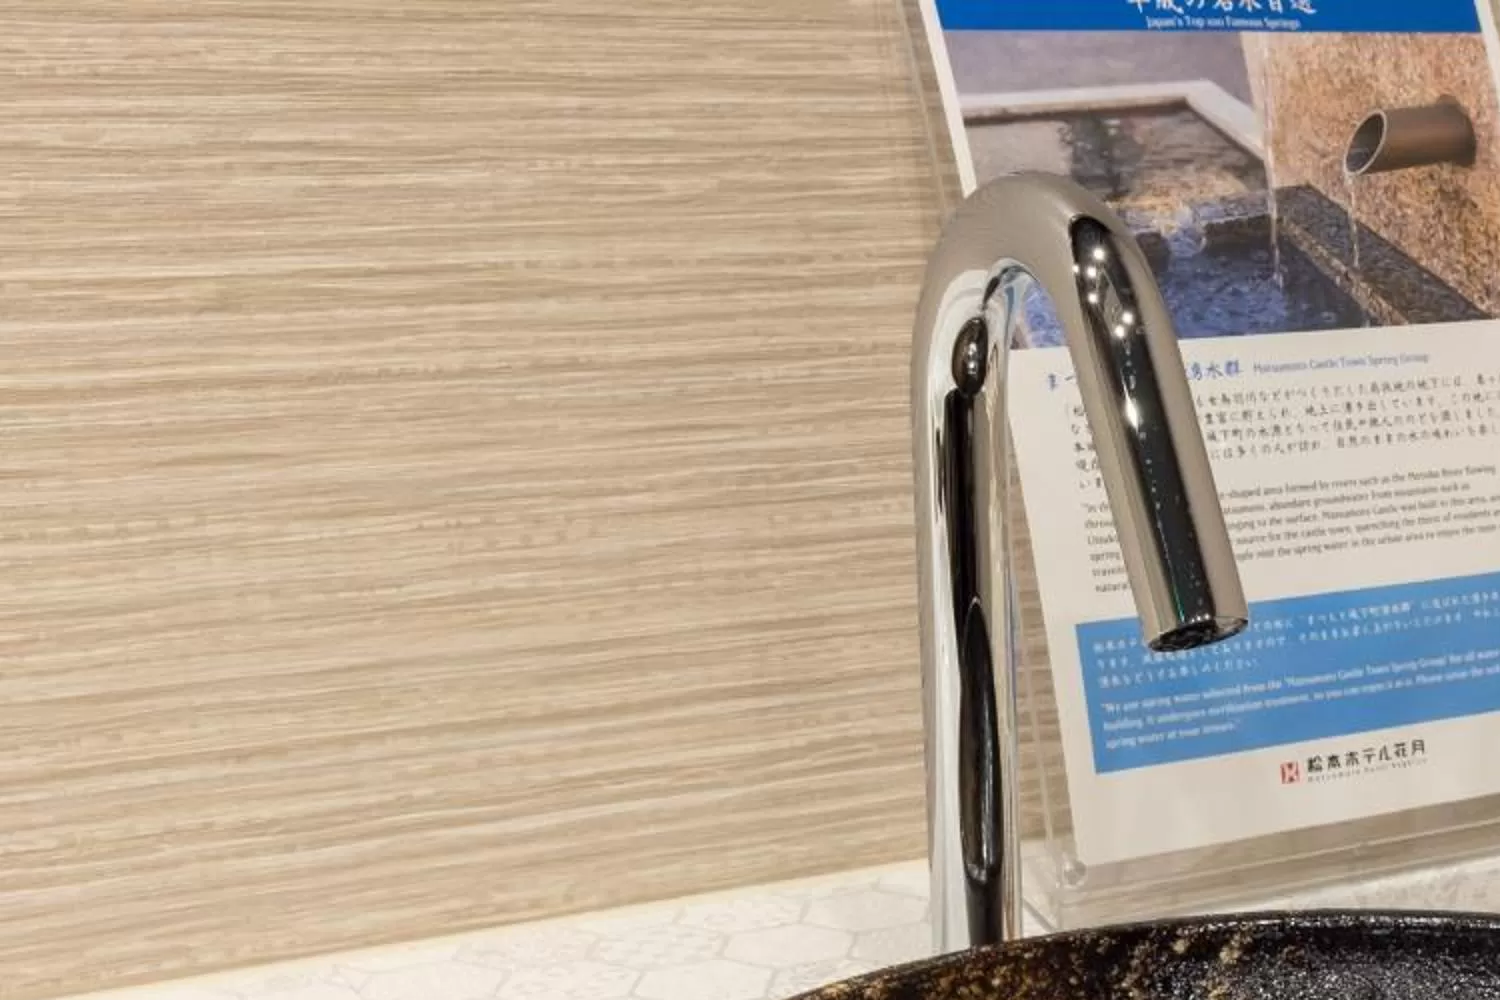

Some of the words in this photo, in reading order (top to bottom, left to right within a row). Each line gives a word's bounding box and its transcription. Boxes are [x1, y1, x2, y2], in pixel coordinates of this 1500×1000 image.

[1185, 16, 1204, 29] Top
[1309, 357, 1338, 369] Castle
[1339, 355, 1366, 367] Town
[1368, 354, 1399, 367] Spring
[1400, 353, 1429, 365] Group
[1307, 739, 1425, 773] 松本ホテル花月
